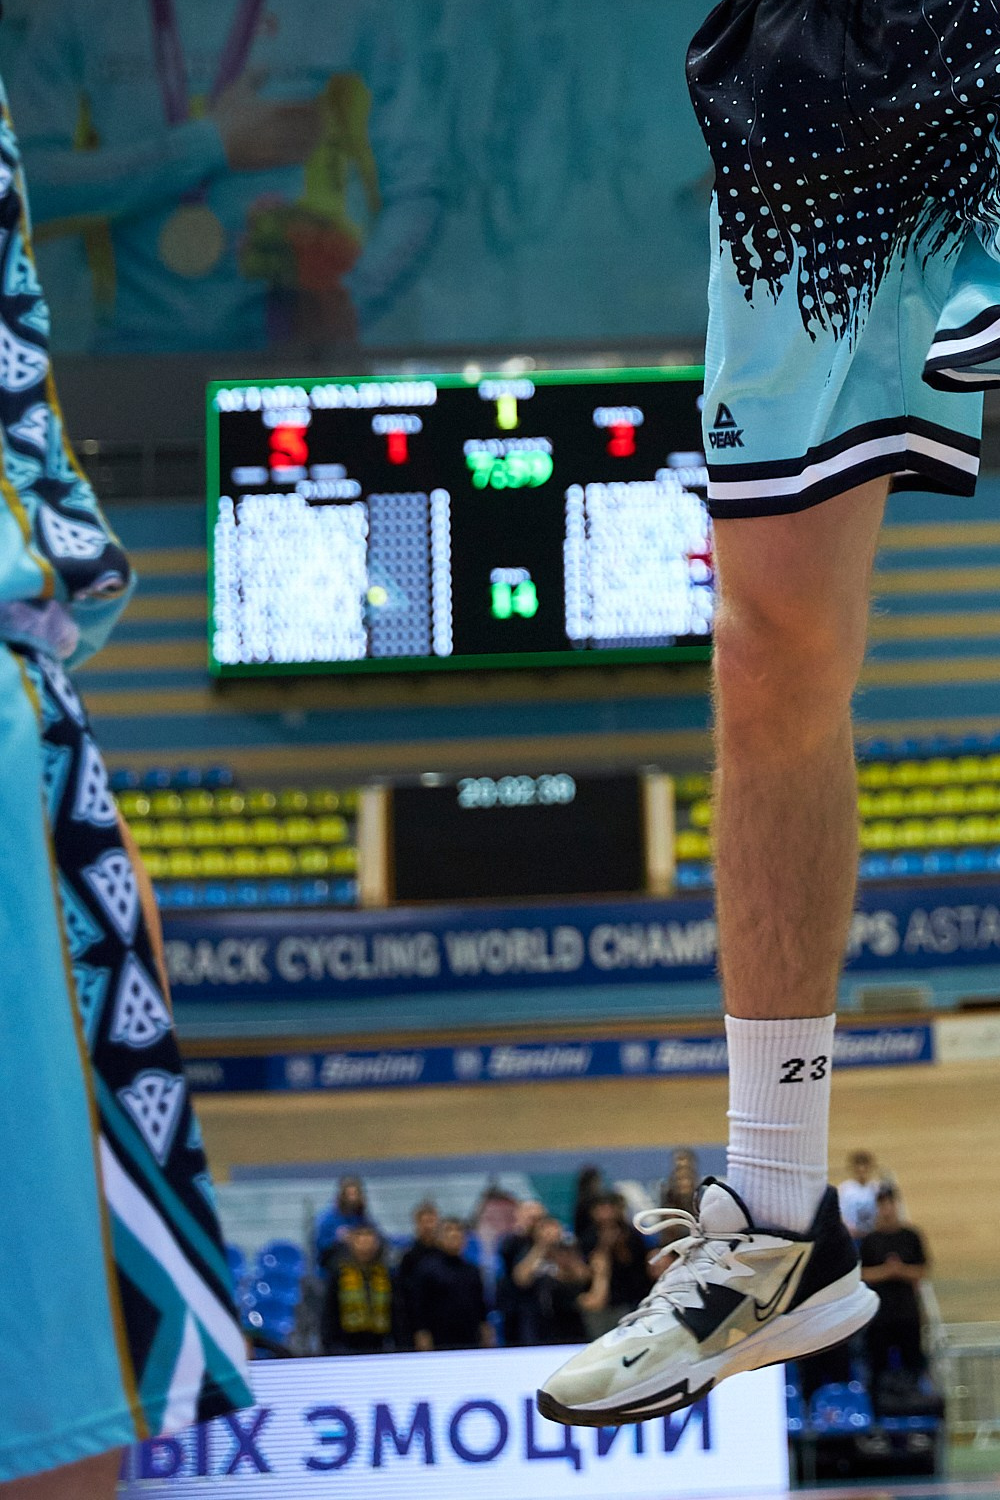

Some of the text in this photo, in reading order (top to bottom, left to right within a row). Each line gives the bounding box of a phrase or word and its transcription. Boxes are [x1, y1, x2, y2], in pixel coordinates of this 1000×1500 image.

[708, 429, 745, 449] PEAK
[163, 938, 272, 986] RACK
[274, 932, 440, 983] CYCLING
[447, 924, 584, 975] WORLD
[779, 1054, 829, 1084] 23
[141, 1407, 272, 1478] ЫХ
